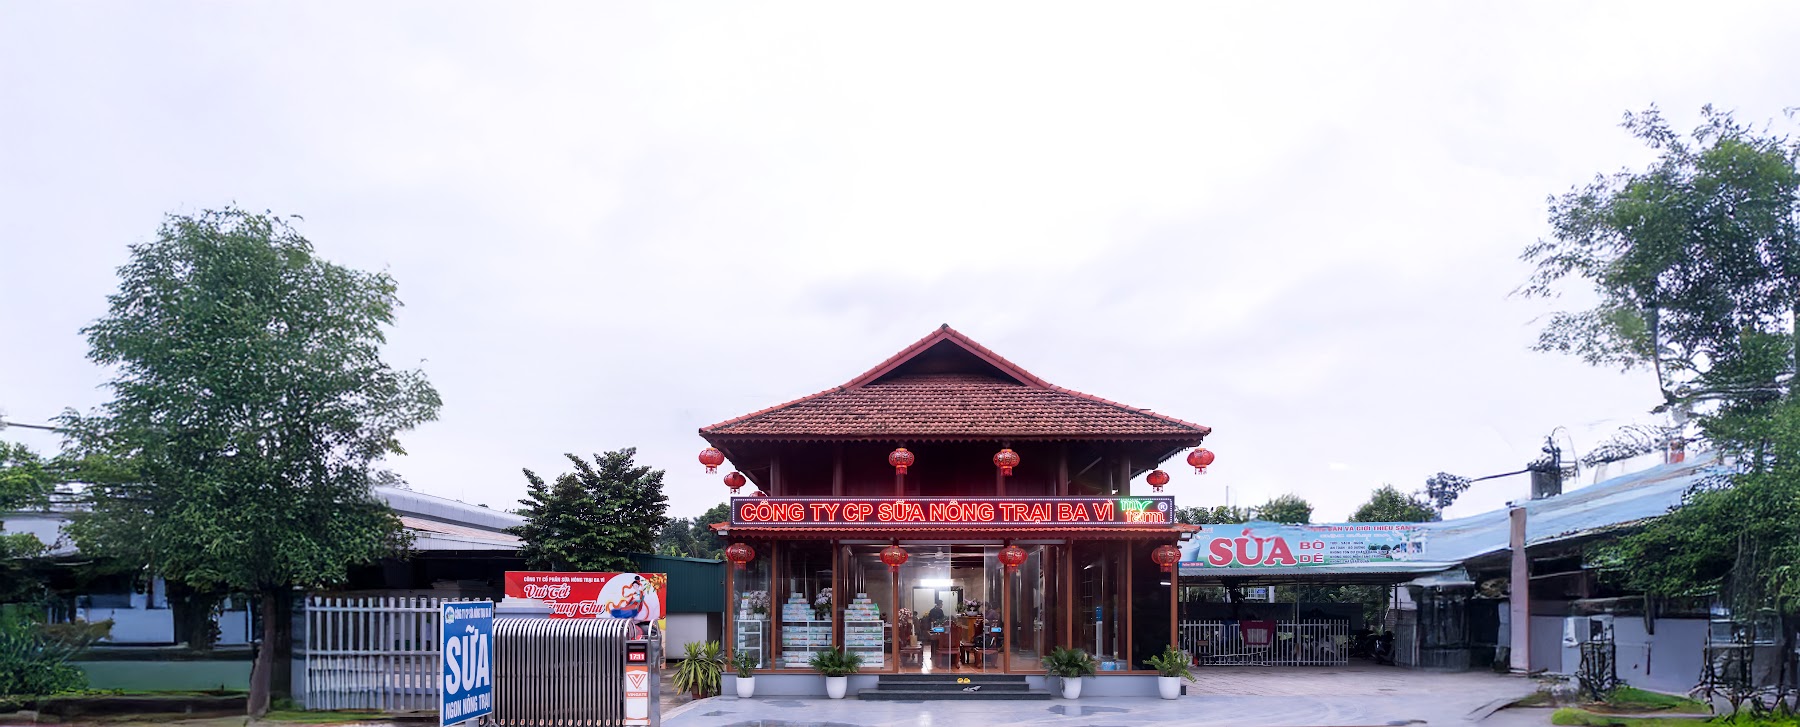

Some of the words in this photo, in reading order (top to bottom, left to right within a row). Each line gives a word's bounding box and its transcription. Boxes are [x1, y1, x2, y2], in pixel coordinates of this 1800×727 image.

[741, 500, 804, 521] CÔNG
[810, 503, 840, 521] TY
[843, 503, 873, 521] CP
[878, 500, 925, 521] SỮA
[930, 500, 994, 521] NÔNG
[999, 503, 1051, 524] TRẠI
[1058, 503, 1089, 521] BA
[1093, 499, 1114, 521] VÌ
[524, 584, 548, 598] Vui
[548, 583, 571, 599] Tết
[445, 624, 490, 695] SỮA
[445, 700, 462, 720] NGON
[463, 694, 478, 715] NÔNG
[479, 692, 491, 710] TRẠI
